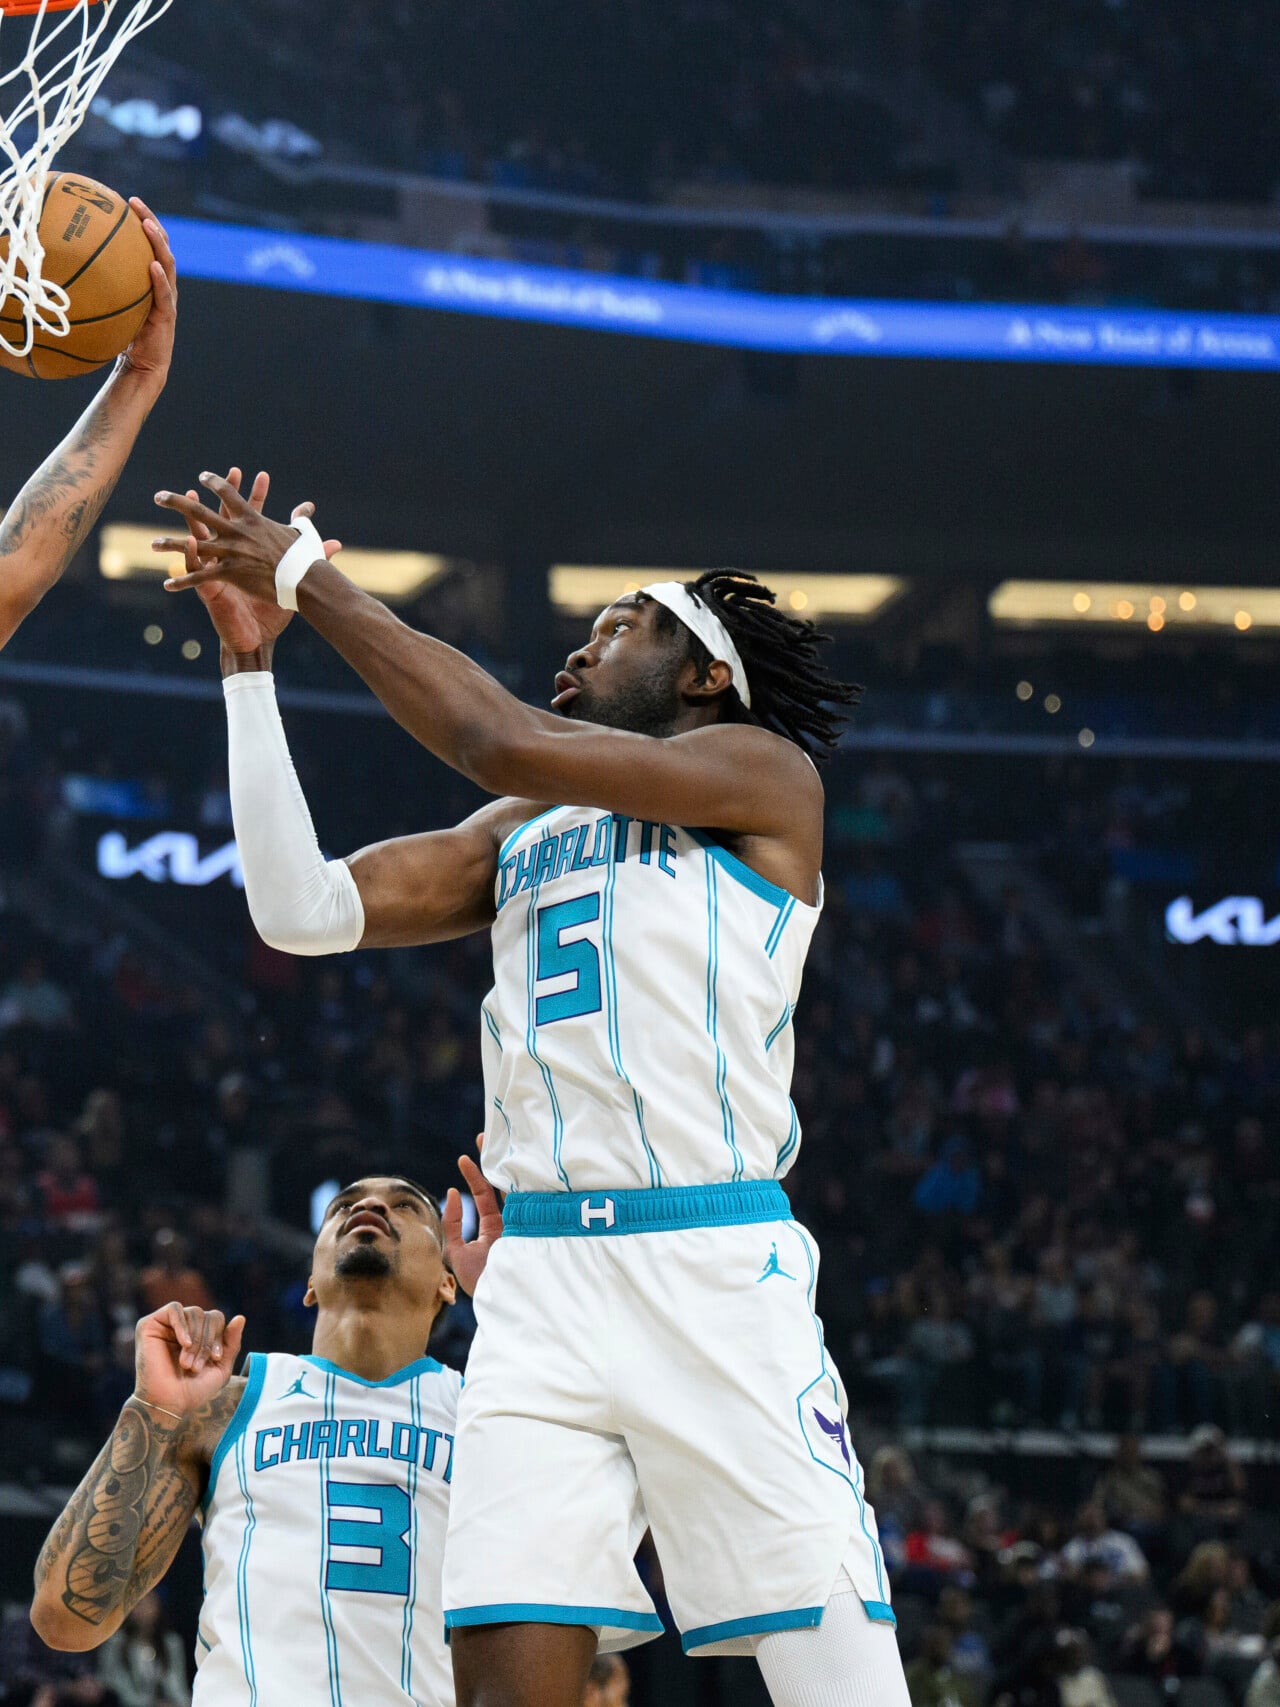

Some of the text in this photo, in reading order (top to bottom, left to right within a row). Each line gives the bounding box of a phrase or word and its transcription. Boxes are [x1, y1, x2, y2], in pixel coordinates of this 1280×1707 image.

[496, 814, 678, 912] CHARLOTTE
[535, 891, 602, 1028] 5
[325, 1480, 412, 1597] 3
